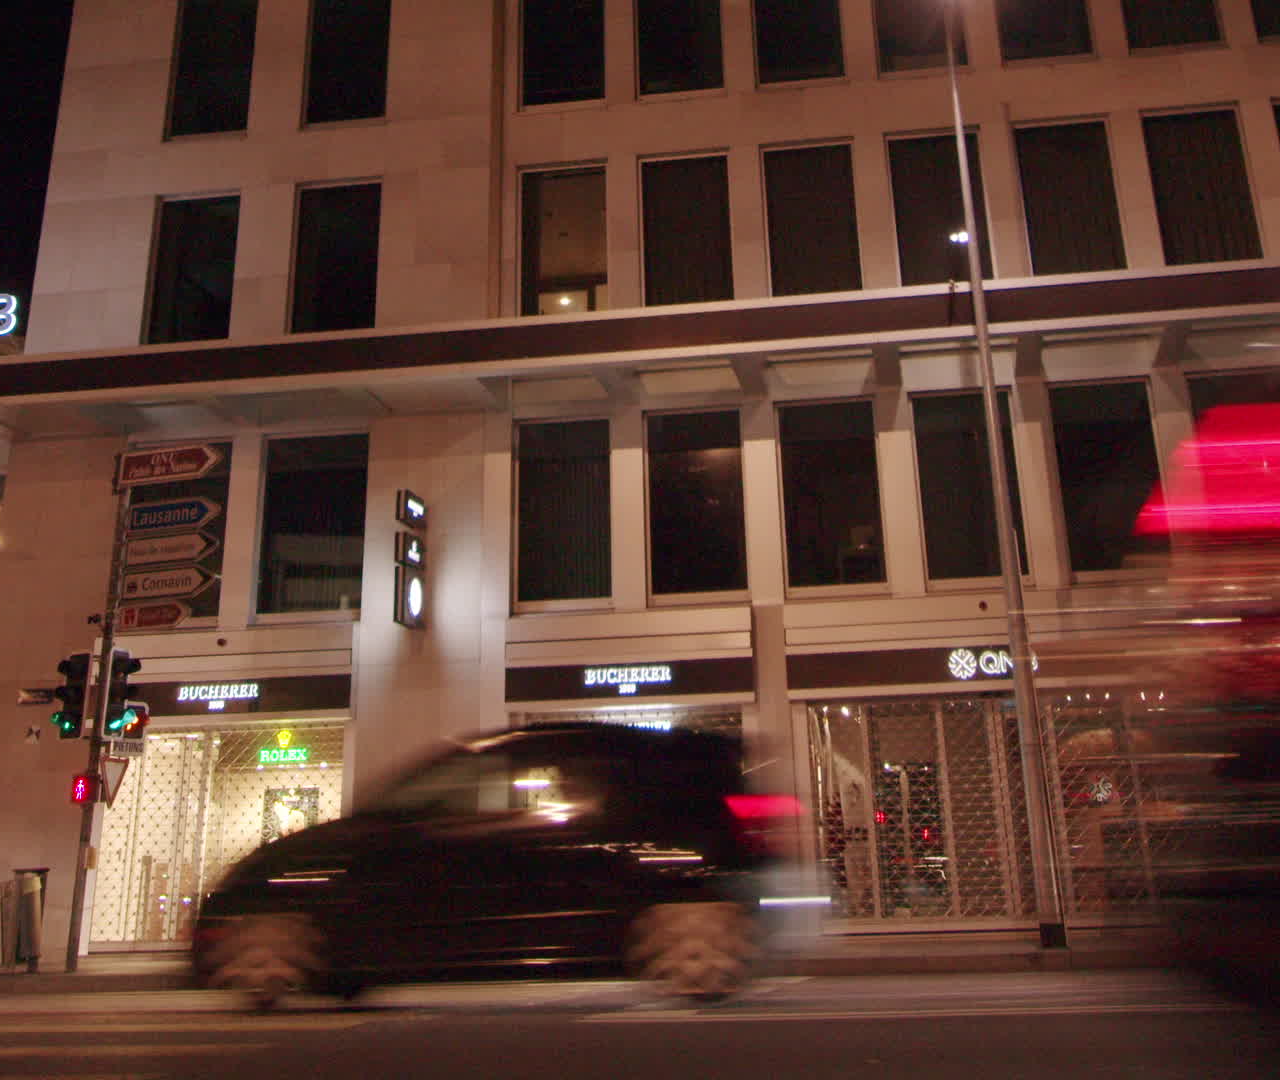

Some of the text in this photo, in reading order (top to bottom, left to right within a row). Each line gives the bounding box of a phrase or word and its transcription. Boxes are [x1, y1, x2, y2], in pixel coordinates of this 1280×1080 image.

[132, 506, 198, 527] Lausanne
[142, 575, 192, 592] Cornavin
[584, 665, 672, 686] BUCHERER
[176, 683, 259, 701] BUCHERER
[260, 748, 308, 764] ROLEX
